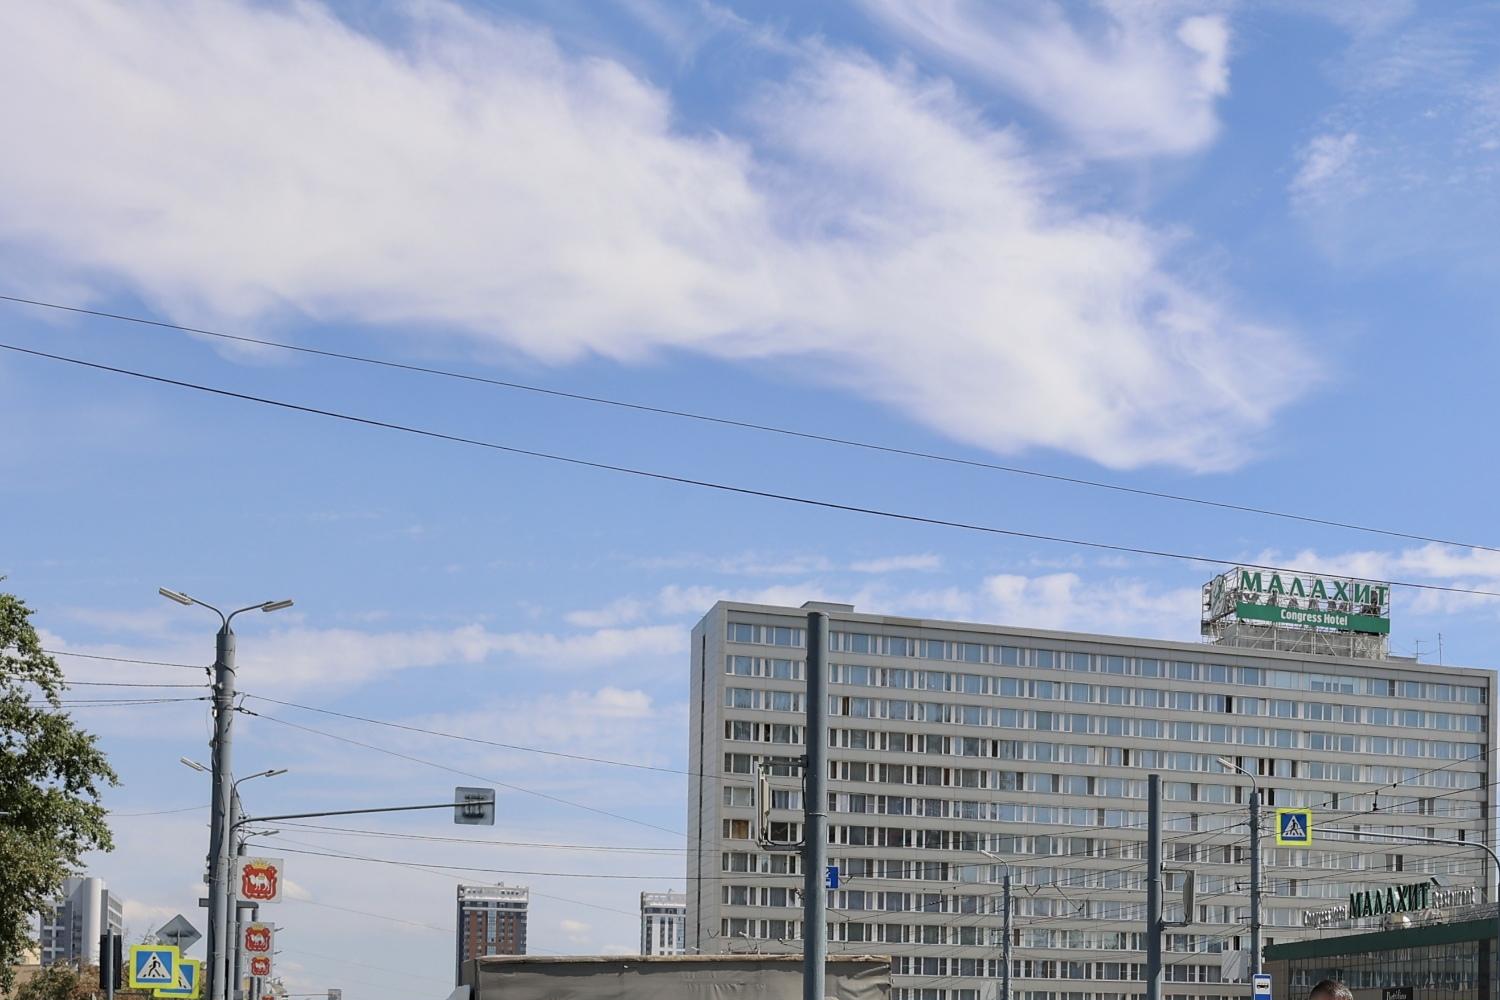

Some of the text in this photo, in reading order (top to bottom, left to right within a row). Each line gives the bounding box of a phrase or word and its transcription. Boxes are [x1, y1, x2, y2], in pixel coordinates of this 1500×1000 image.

[1240, 570, 1389, 606] МАЛАХИТ
[1280, 609, 1348, 626] Congress Hotel
[1349, 882, 1431, 919] МАЛАХИТ
